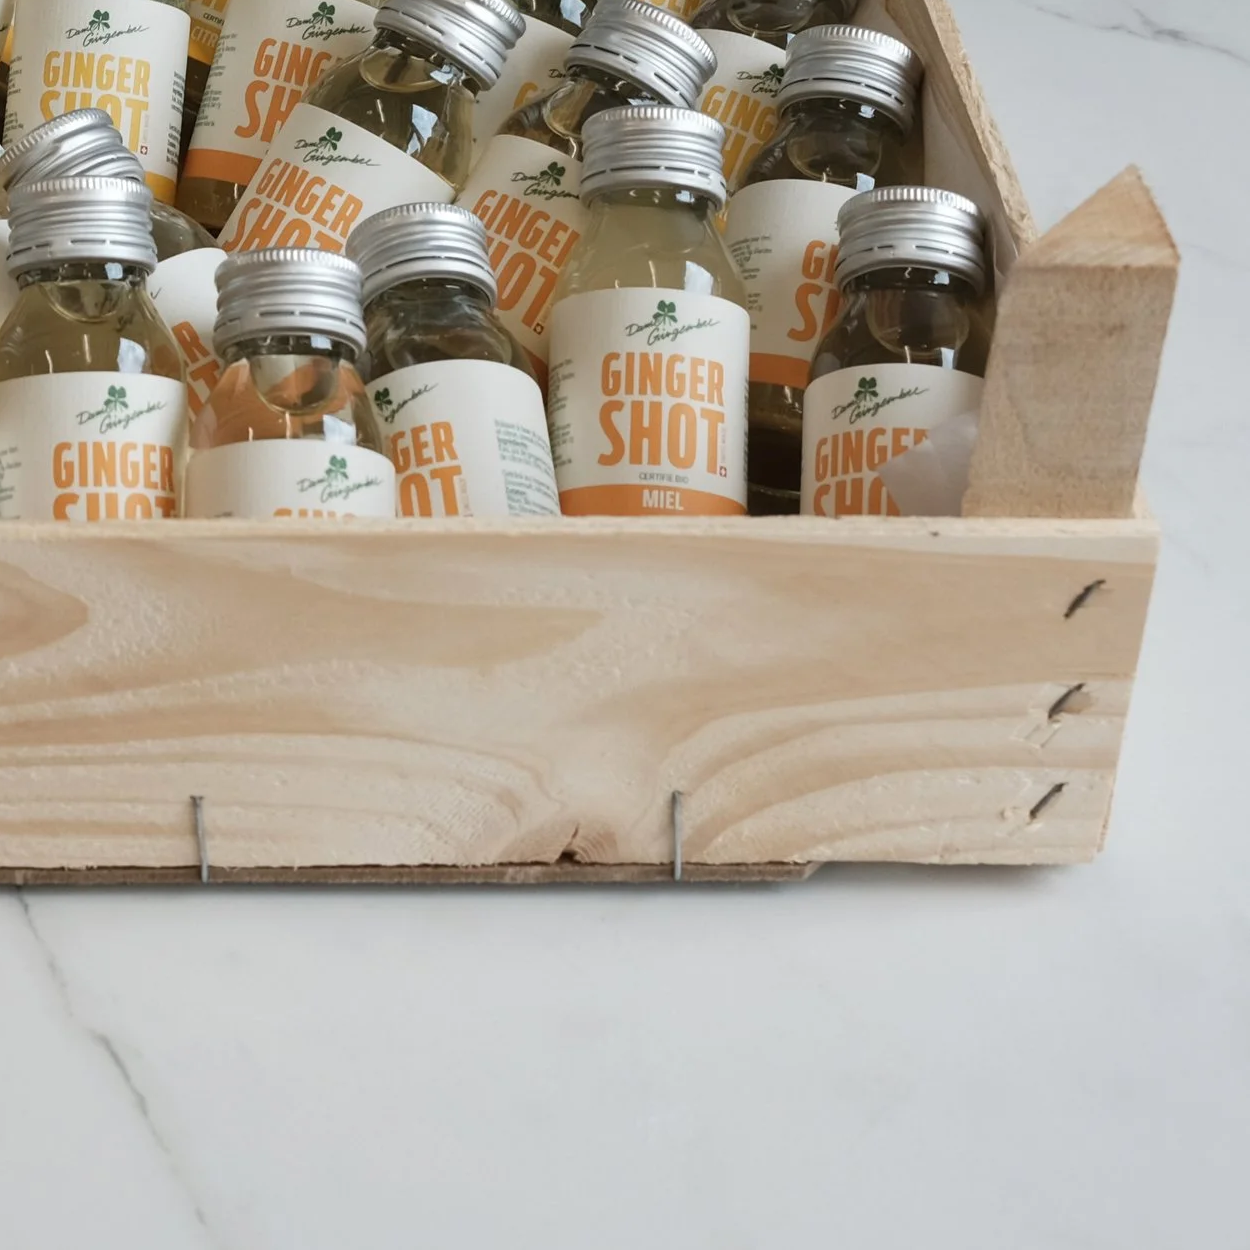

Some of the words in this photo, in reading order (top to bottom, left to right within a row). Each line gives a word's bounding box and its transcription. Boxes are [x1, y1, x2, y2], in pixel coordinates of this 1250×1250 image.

[191, 26, 218, 47] CITR
[203, 12, 225, 26] CERTIFI
[43, 50, 151, 98] GINGER
[253, 38, 333, 88] GING
[234, 80, 304, 143] SH
[701, 85, 778, 143] GING
[255, 158, 364, 239] GINGER
[601, 352, 724, 407] GINGER
[390, 421, 459, 474] GER
[598, 400, 726, 475] SHOT
[53, 441, 176, 492] GINGER
[400, 465, 463, 518] OT
[642, 488, 684, 511] MIEL
